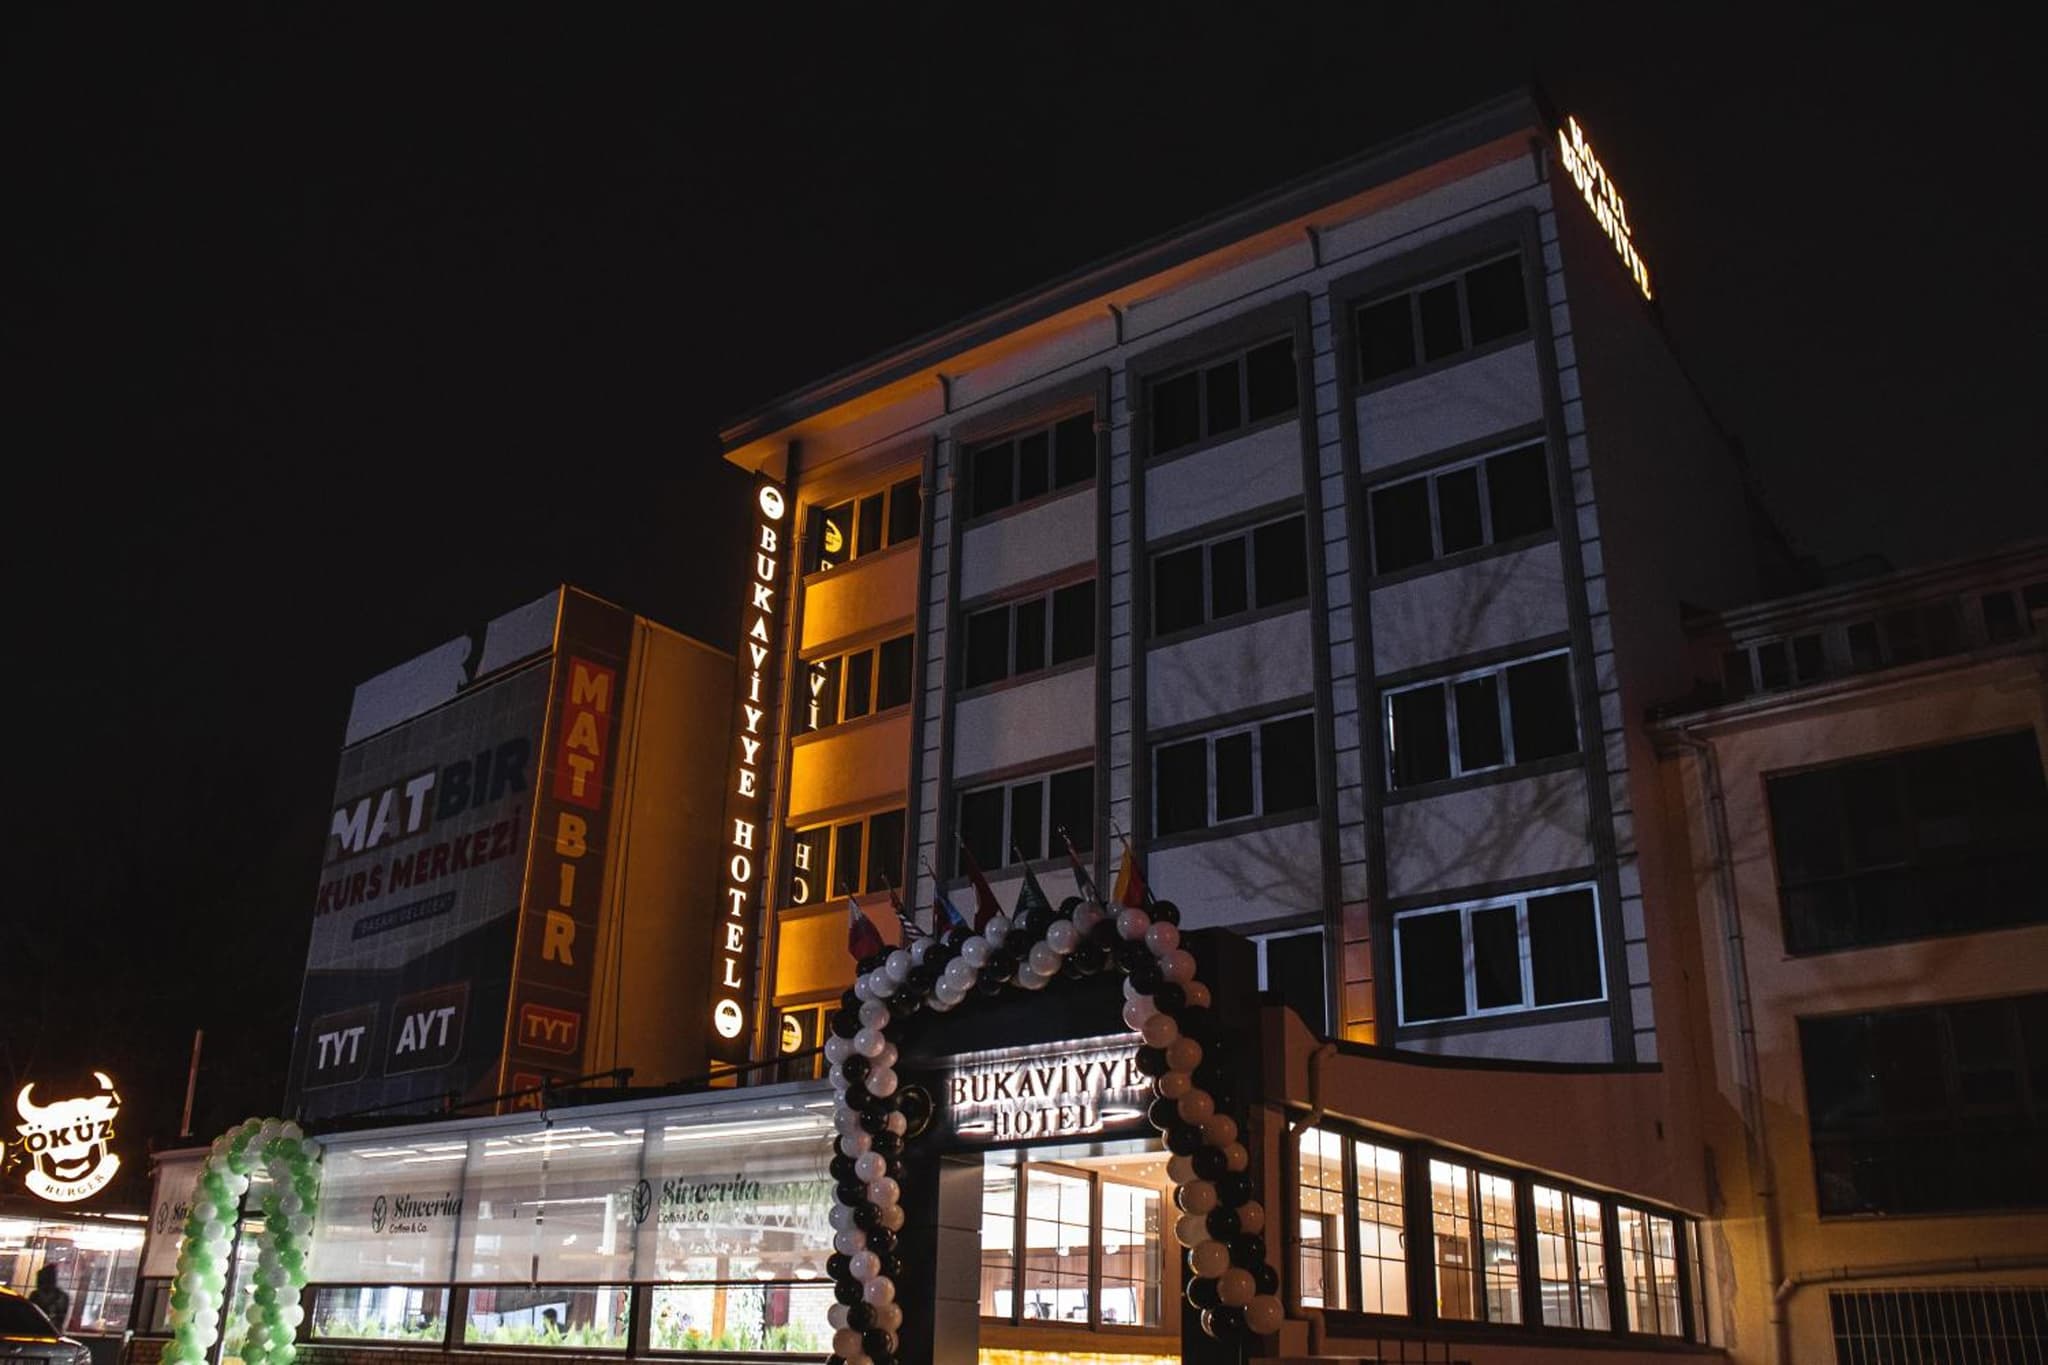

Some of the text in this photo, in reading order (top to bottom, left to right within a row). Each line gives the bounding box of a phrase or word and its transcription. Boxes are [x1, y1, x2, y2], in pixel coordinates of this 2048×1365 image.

[1569, 116, 1631, 237] HOTEL
[723, 523, 778, 988] BUKAVİYYE HOTEL
[316, 805, 521, 915] KURS MERKEZİ
[318, 1026, 366, 1070] TYT
[395, 1006, 455, 1055] AYT
[527, 1014, 573, 1043] TYT
[951, 1057, 1146, 1105] BUKAVİYYE
[26, 1116, 114, 1152] ÖKÜZ
[993, 1104, 1096, 1137] HOTEL
[44, 1174, 105, 1197] BURGER
